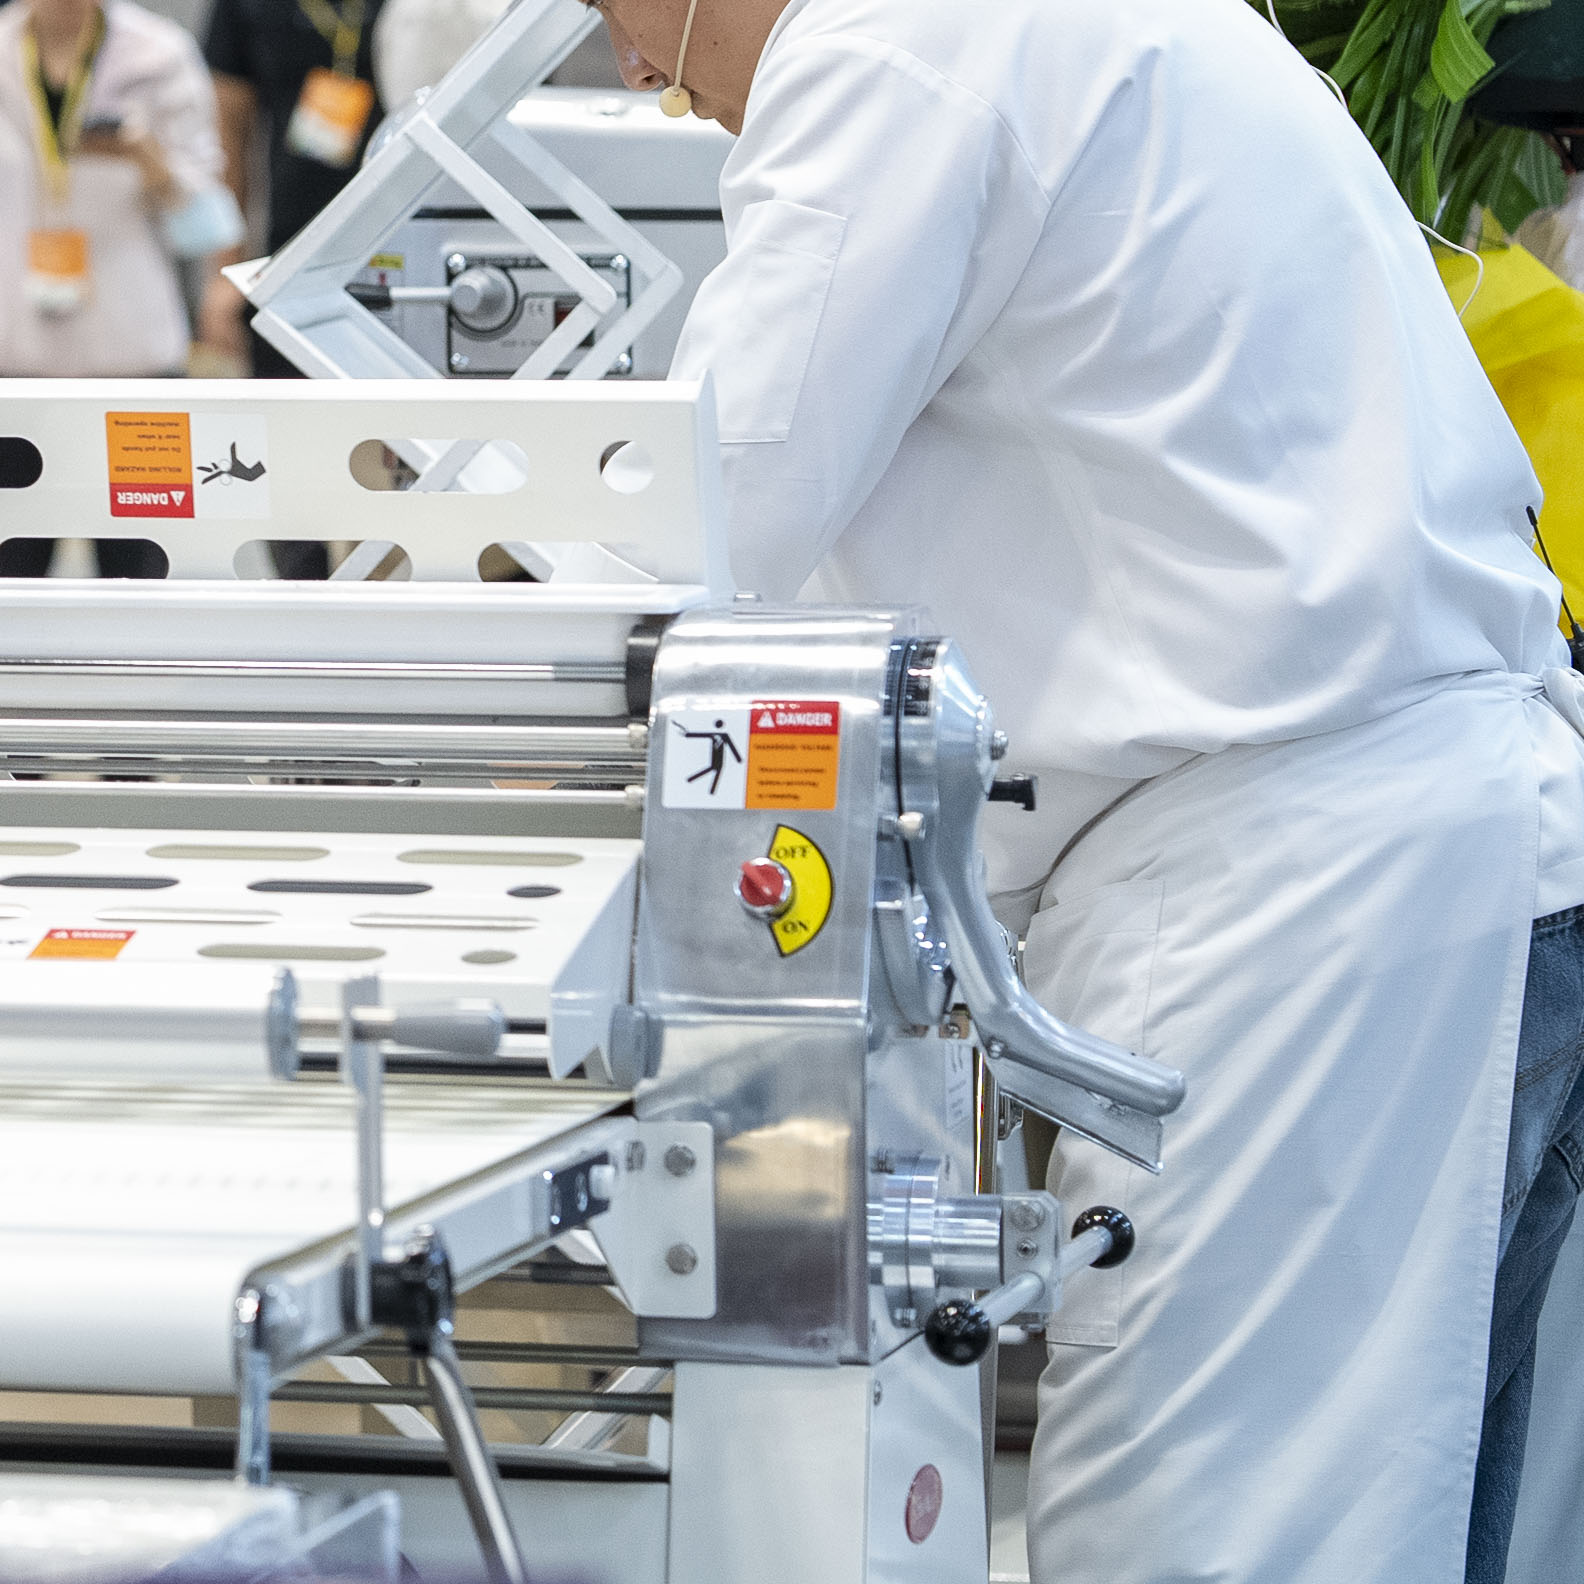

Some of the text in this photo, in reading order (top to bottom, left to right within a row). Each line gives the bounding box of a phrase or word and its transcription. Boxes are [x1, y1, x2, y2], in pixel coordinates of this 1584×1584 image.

[117, 492, 169, 505] DANGER
[775, 712, 833, 727] DANGER
[775, 844, 810, 860] OFF
[782, 920, 809, 935] ON
